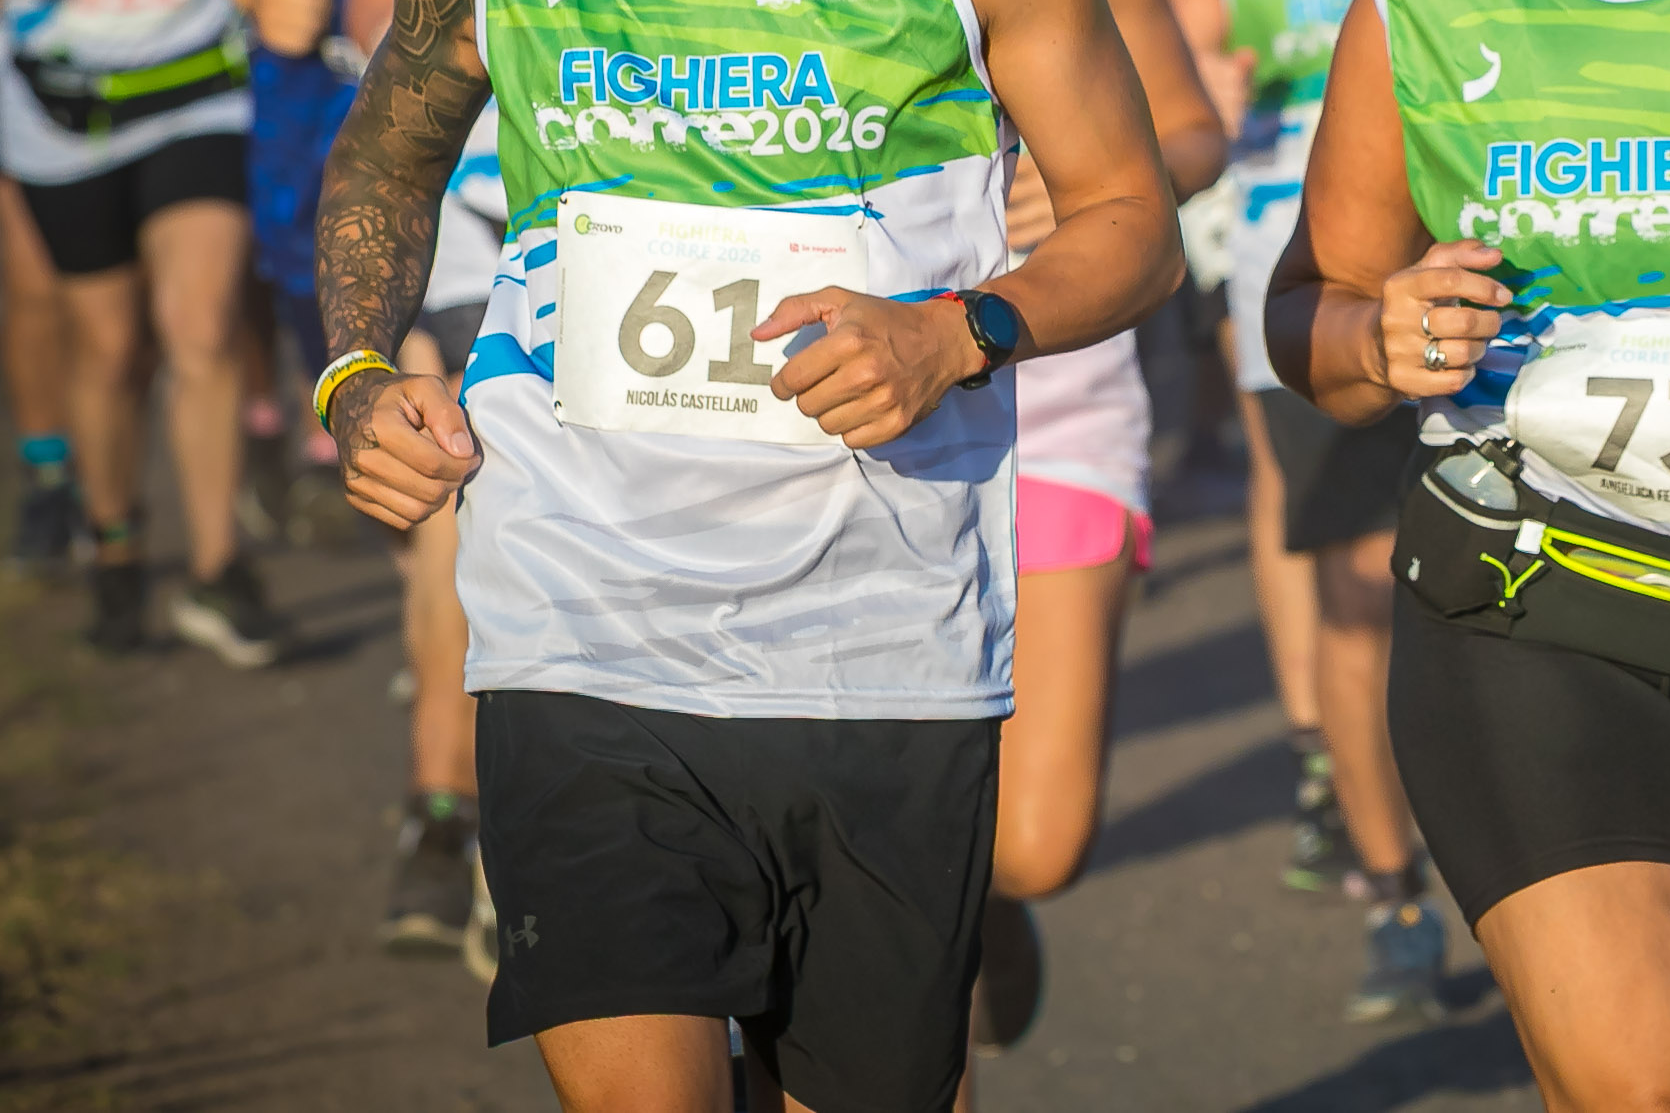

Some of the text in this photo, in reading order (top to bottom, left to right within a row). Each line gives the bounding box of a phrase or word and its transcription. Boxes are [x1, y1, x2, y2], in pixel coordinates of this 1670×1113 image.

[559, 47, 838, 112] FIGHIERA
[658, 221, 748, 245] FIGHIERA
[647, 238, 761, 264] CORRE 2026
[618, 270, 773, 386] 61
[1610, 349, 1670, 365] CORRE
[626, 388, 758, 414] NICOLÁS CASTELLANO
